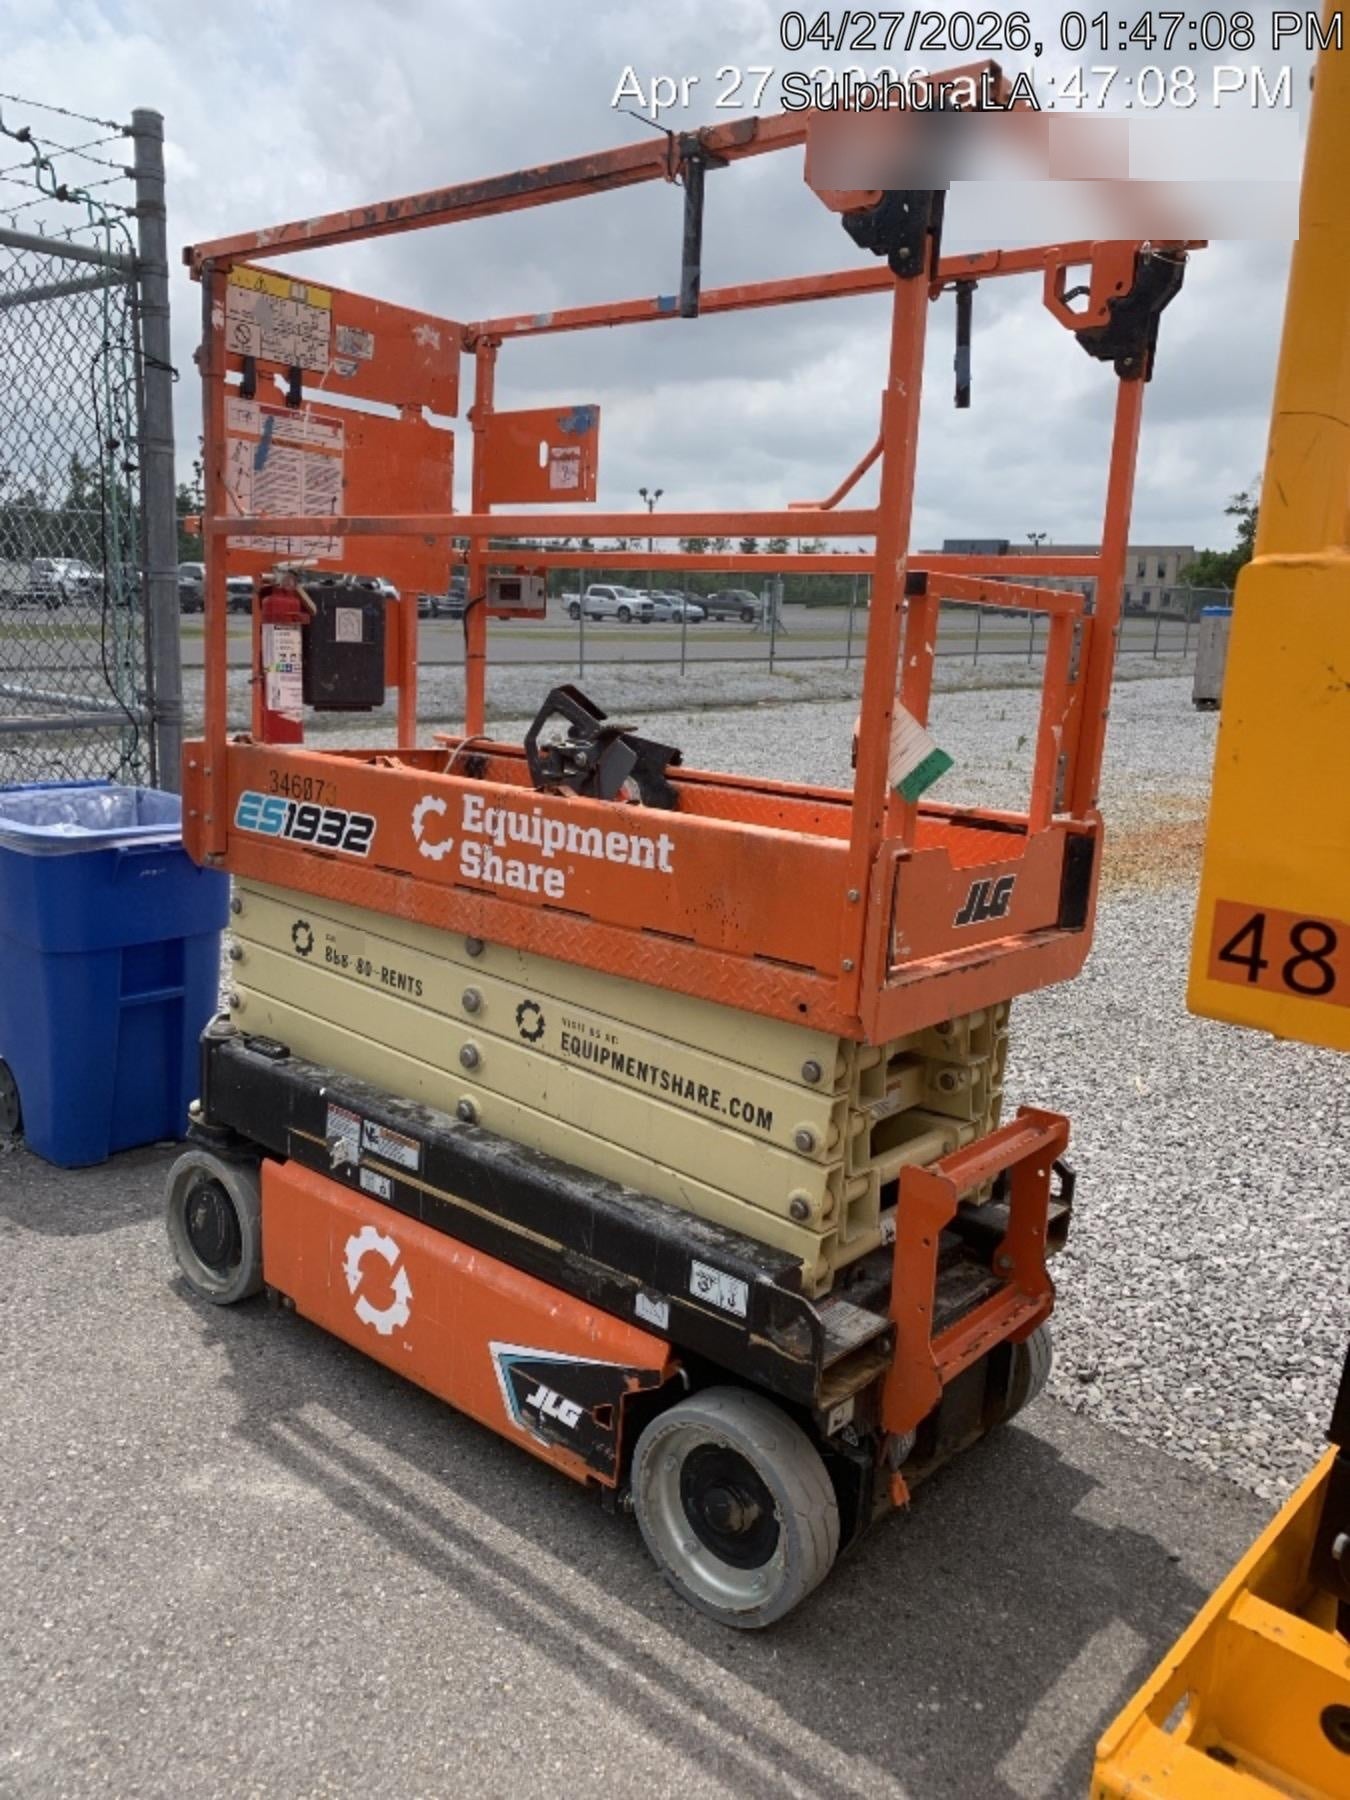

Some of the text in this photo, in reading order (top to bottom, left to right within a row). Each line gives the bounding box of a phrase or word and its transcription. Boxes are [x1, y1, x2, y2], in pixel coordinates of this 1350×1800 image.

[236, 792, 376, 855] ES1932
[461, 793, 674, 873] Equipment
[459, 839, 565, 899] Share
[953, 874, 1016, 928] JLG
[1218, 912, 1337, 996] 48
[561, 1031, 773, 1131] EQUIPMENTSHARE.COM
[525, 1384, 584, 1429] JLG
